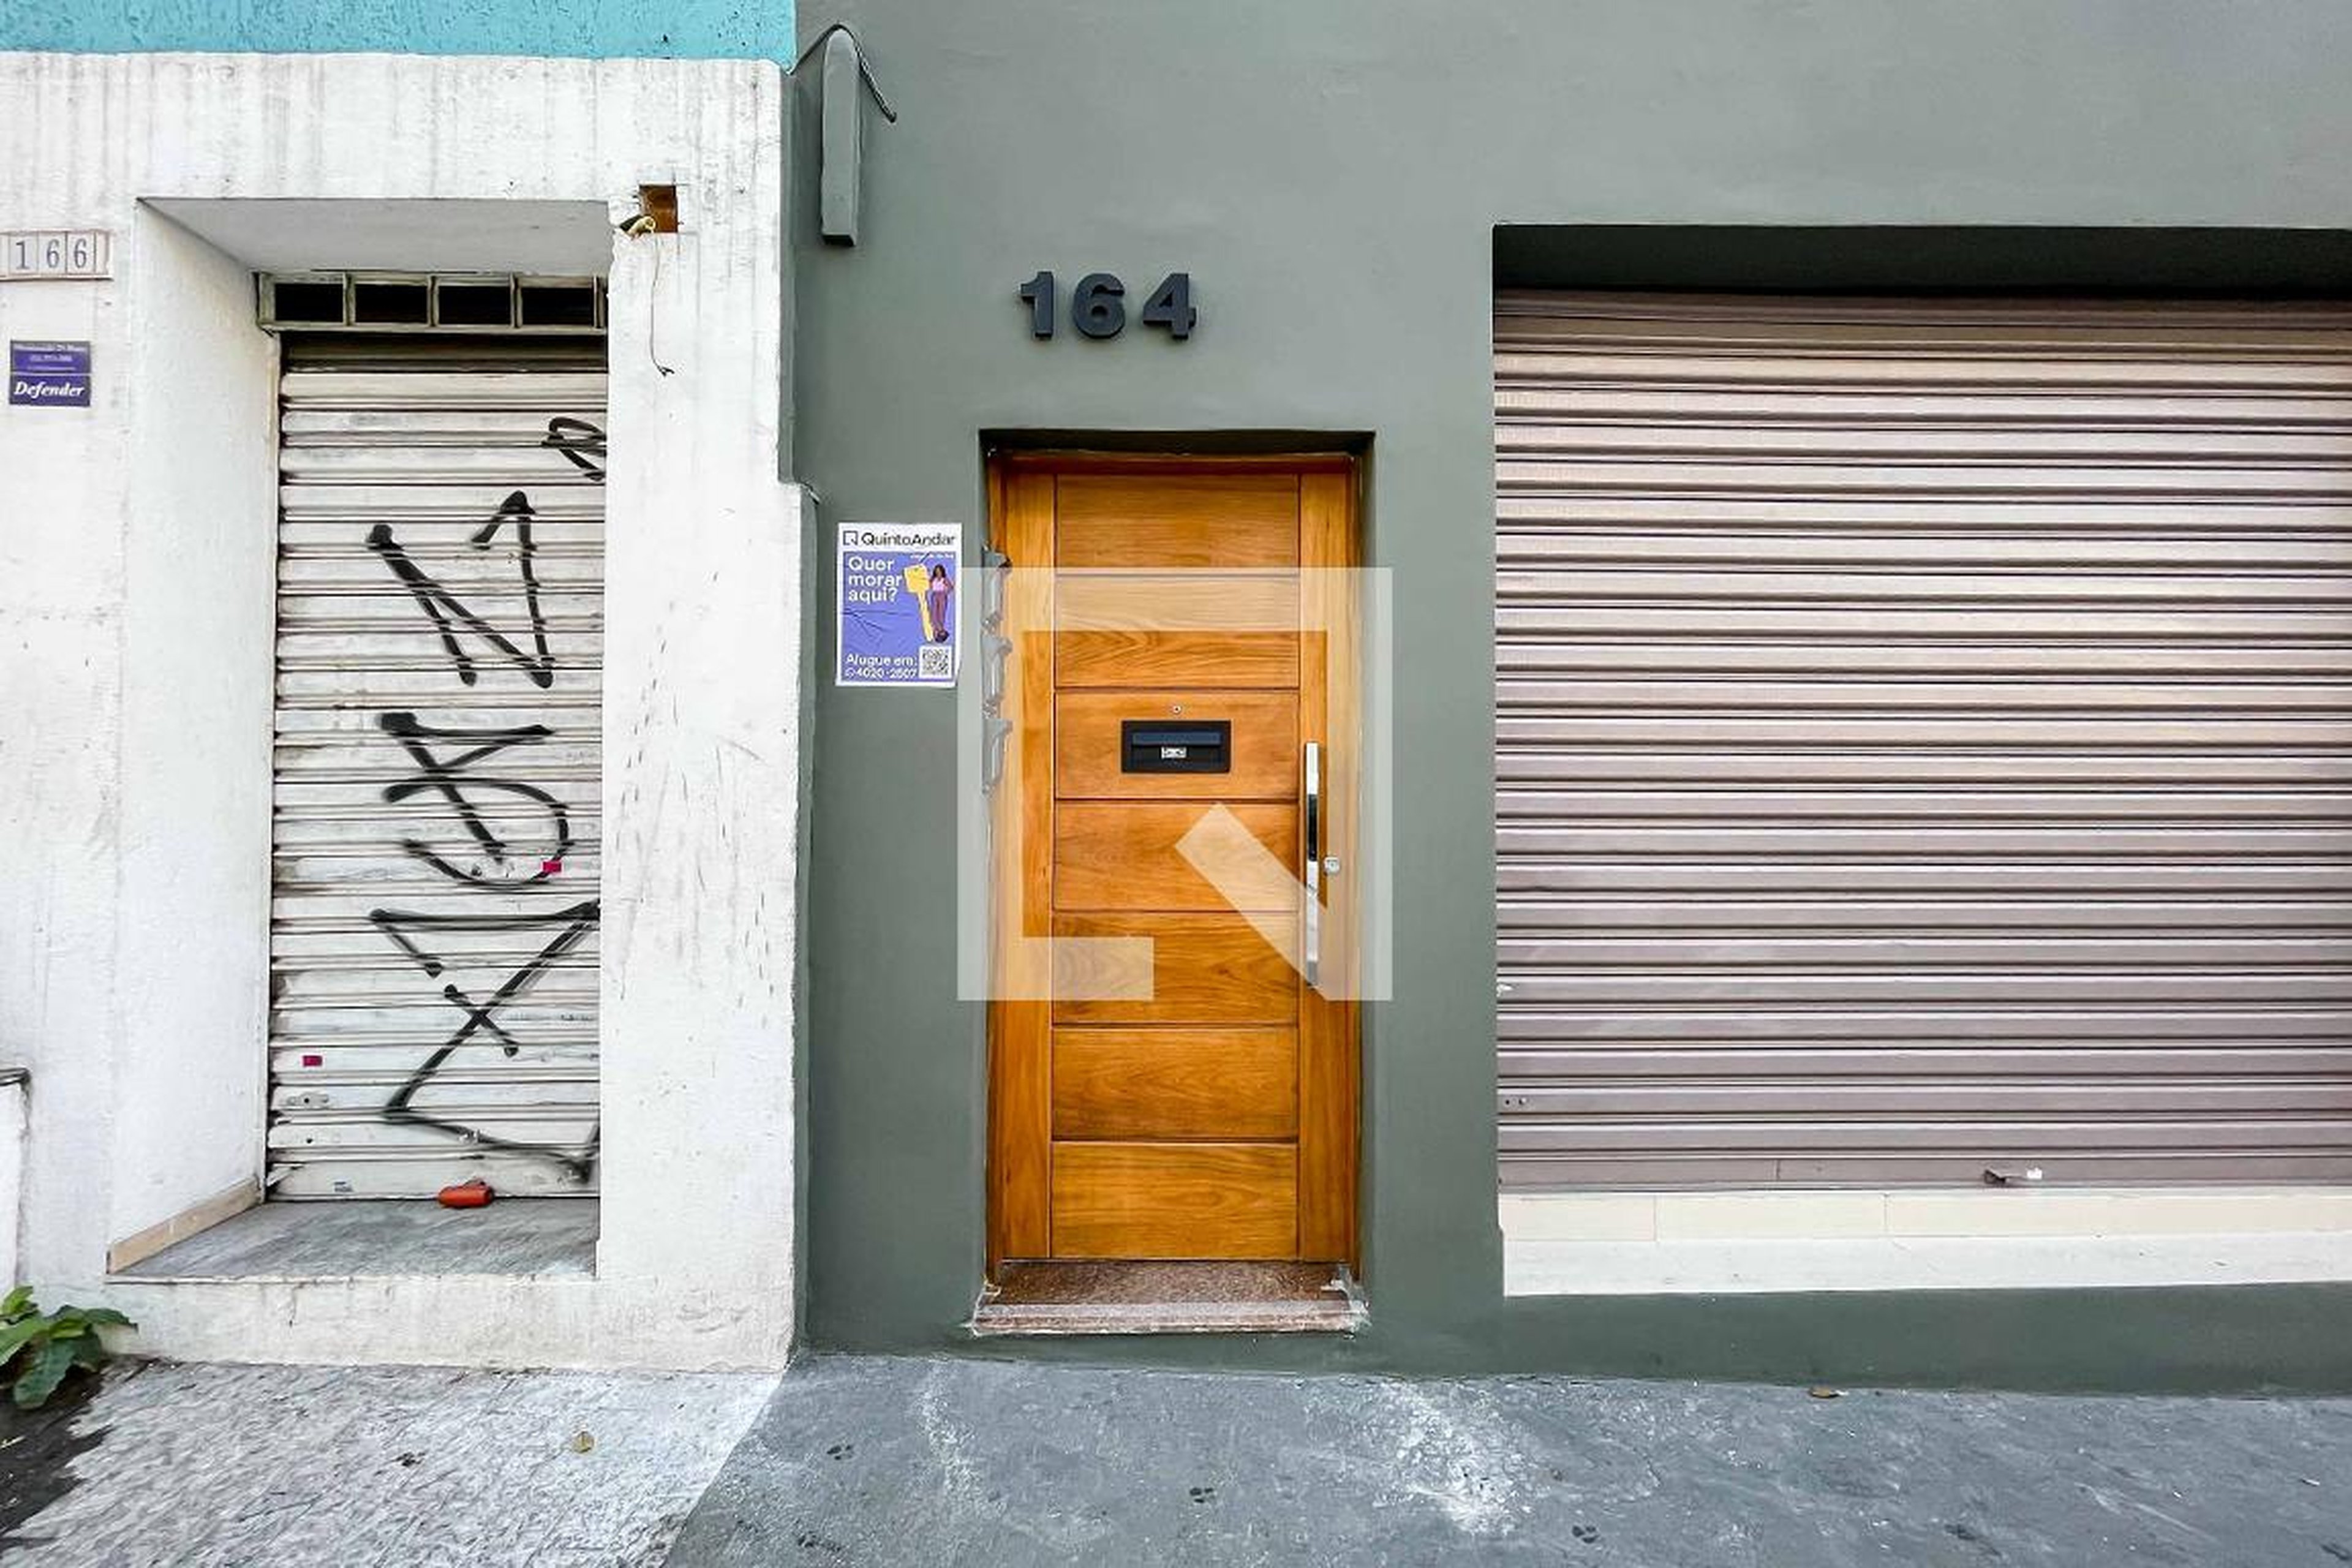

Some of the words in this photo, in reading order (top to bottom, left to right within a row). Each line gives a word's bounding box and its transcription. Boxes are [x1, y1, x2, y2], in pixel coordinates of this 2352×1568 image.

[15, 239, 87, 270] 166
[1020, 271, 1197, 340] 164
[13, 381, 85, 399] Defender
[861, 532, 956, 546] QuintoAndar
[848, 556, 894, 571] Quer
[848, 575, 902, 587] morar
[848, 588, 899, 605] aqui?
[846, 654, 891, 667] Alugue
